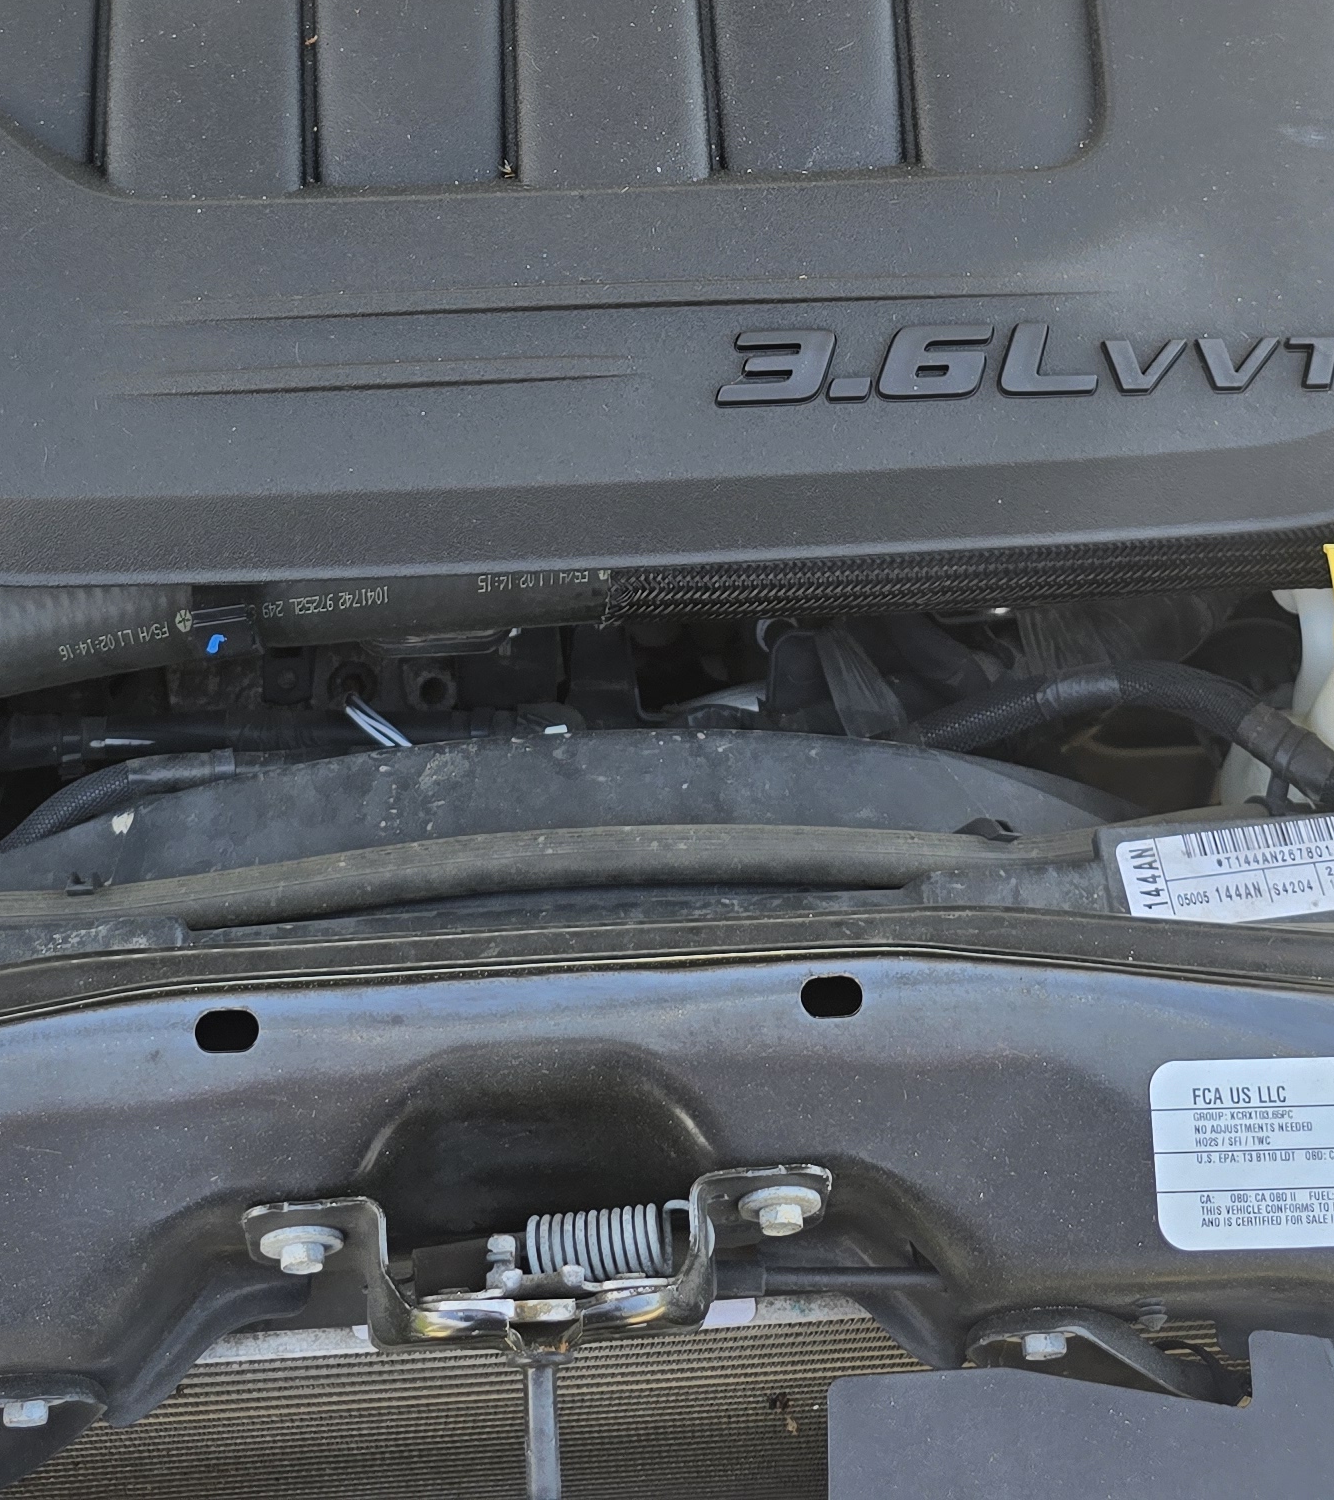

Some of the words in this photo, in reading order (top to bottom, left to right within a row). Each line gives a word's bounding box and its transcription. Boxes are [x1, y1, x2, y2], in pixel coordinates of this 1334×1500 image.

[714, 322, 1099, 408] 3.6L
[338, 585, 389, 607] 1041742
[261, 600, 284, 618] 249
[1129, 847, 1168, 910] 144AN
[1177, 891, 1210, 907] 05005
[1216, 881, 1263, 904] 144AN
[1272, 879, 1314, 896] S4204
[1192, 1087, 1225, 1105] FCA
[1229, 1086, 1252, 1105] US
[1257, 1085, 1288, 1104] LLC
[1193, 1111, 1228, 1121] GROUP:
[1194, 1124, 1207, 1135] NO
[1209, 1122, 1276, 1134] ADJUSTMENTS
[1278, 1122, 1313, 1133] NEEDED
[1228, 1136, 1242, 1146] SFI
[1251, 1135, 1271, 1146] TWC
[1196, 1153, 1216, 1164] U.S.
[1218, 1152, 1240, 1163] EPA:
[1242, 1152, 1254, 1162] T3
[1280, 1151, 1296, 1161] LDT
[1199, 1194, 1215, 1204] CA:
[1254, 1192, 1267, 1203] CA
[1309, 1190, 1334, 1201] FUEL:
[1201, 1205, 1221, 1216] THIS
[1225, 1203, 1263, 1215] VEHICLE
[1265, 1202, 1315, 1214] CONFORMS
[1318, 1201, 1330, 1212] TO
[1201, 1217, 1219, 1228] AND
[1223, 1217, 1233, 1227] IS
[1235, 1215, 1282, 1227] CERTIFIED
[1285, 1214, 1303, 1225] FOR
[1306, 1214, 1328, 1225] SALE
